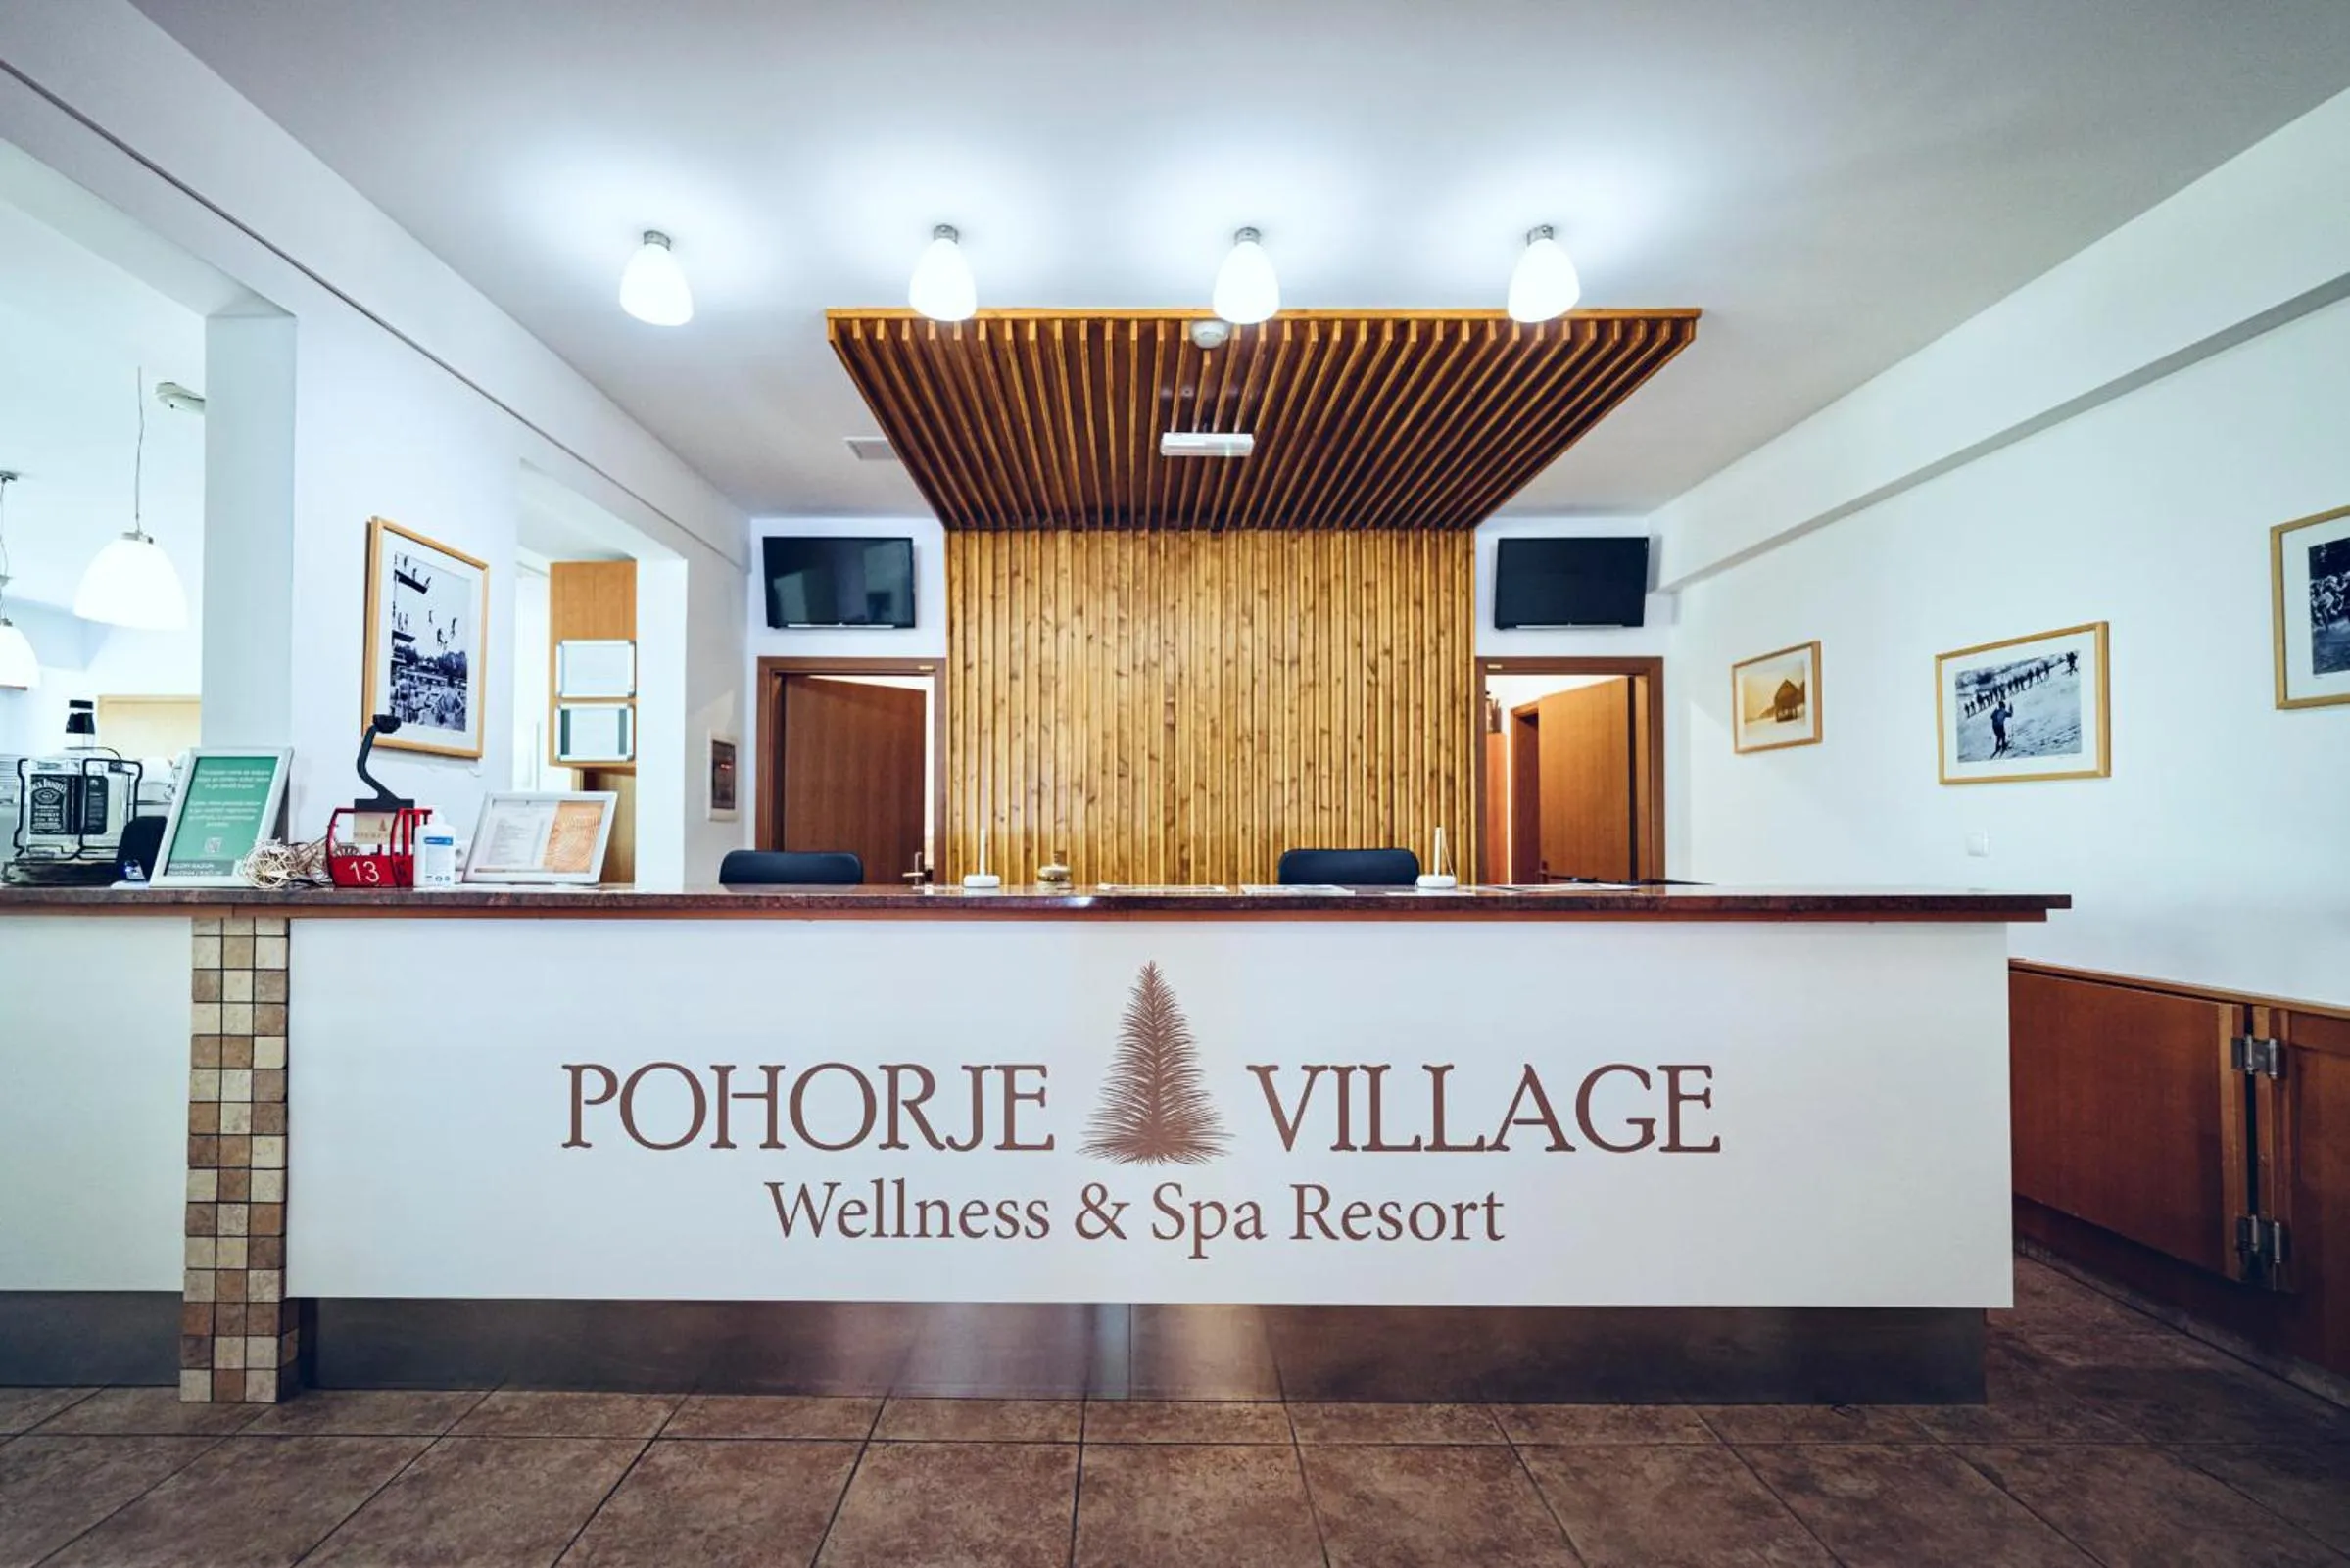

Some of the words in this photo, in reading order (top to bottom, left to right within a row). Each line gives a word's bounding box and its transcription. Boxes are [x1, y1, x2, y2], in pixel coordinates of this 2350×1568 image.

[349, 861, 380, 883] 13
[561, 1062, 1055, 1152] POHORJE
[1245, 1063, 1721, 1154] VILLAGE
[763, 1177, 1050, 1240] Wellness
[1075, 1182, 1130, 1240] &
[1152, 1182, 1268, 1259] Spa
[1289, 1183, 1506, 1242] Resort
